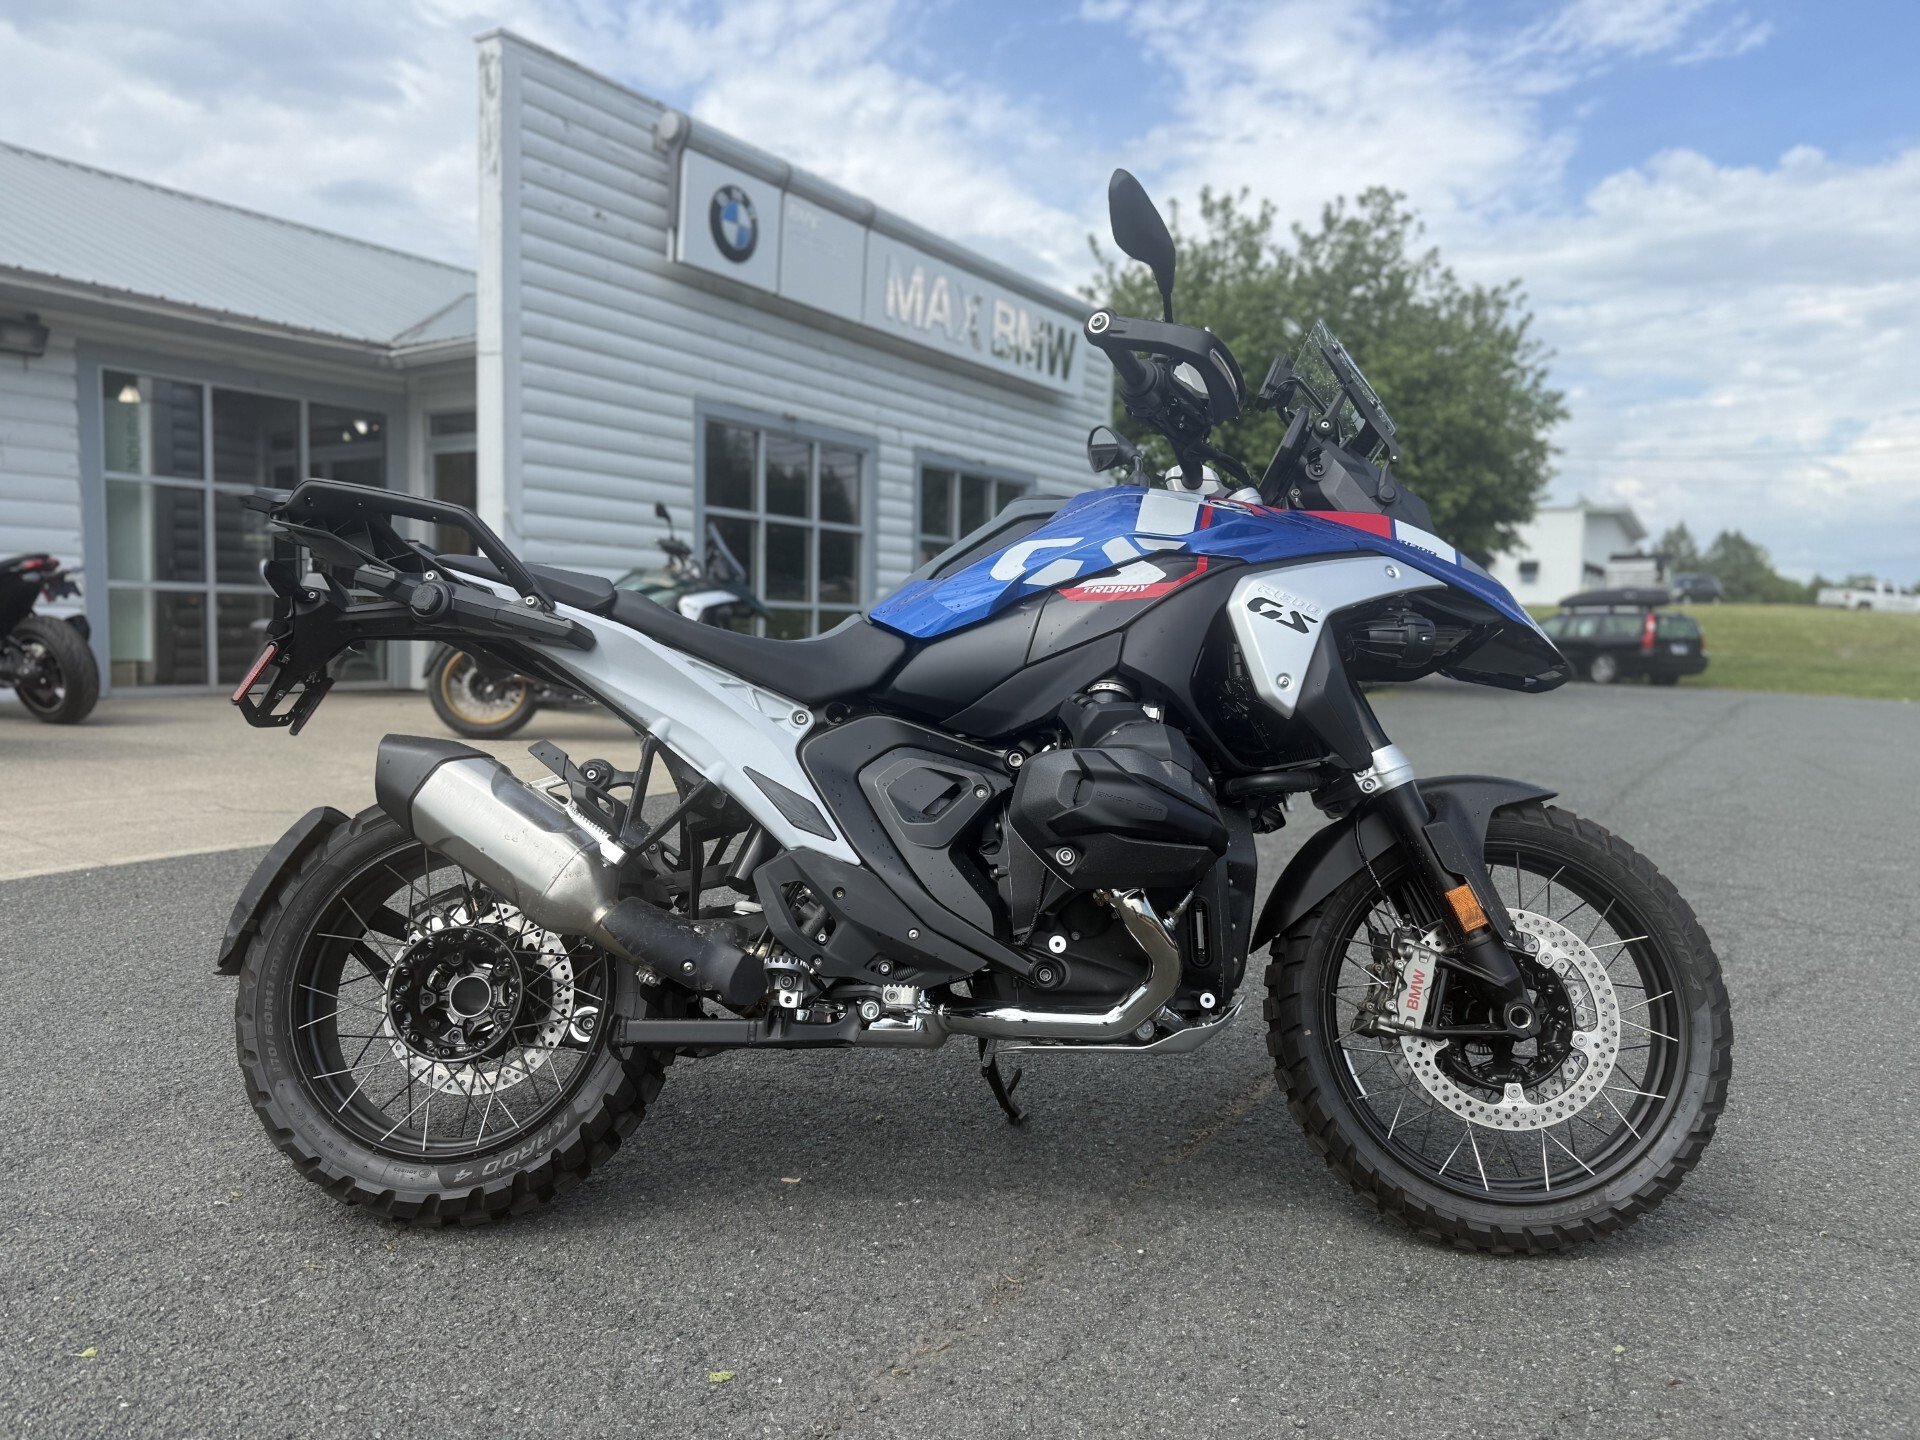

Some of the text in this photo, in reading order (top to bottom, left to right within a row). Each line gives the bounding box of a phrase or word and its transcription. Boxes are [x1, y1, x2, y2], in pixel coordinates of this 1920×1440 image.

[883, 254, 1077, 382] MAX BMW
[1083, 584, 1150, 594] TROPHY
[1246, 596, 1319, 635] GS
[1406, 968, 1426, 1011] BMW
[453, 1168, 473, 1183] 4
